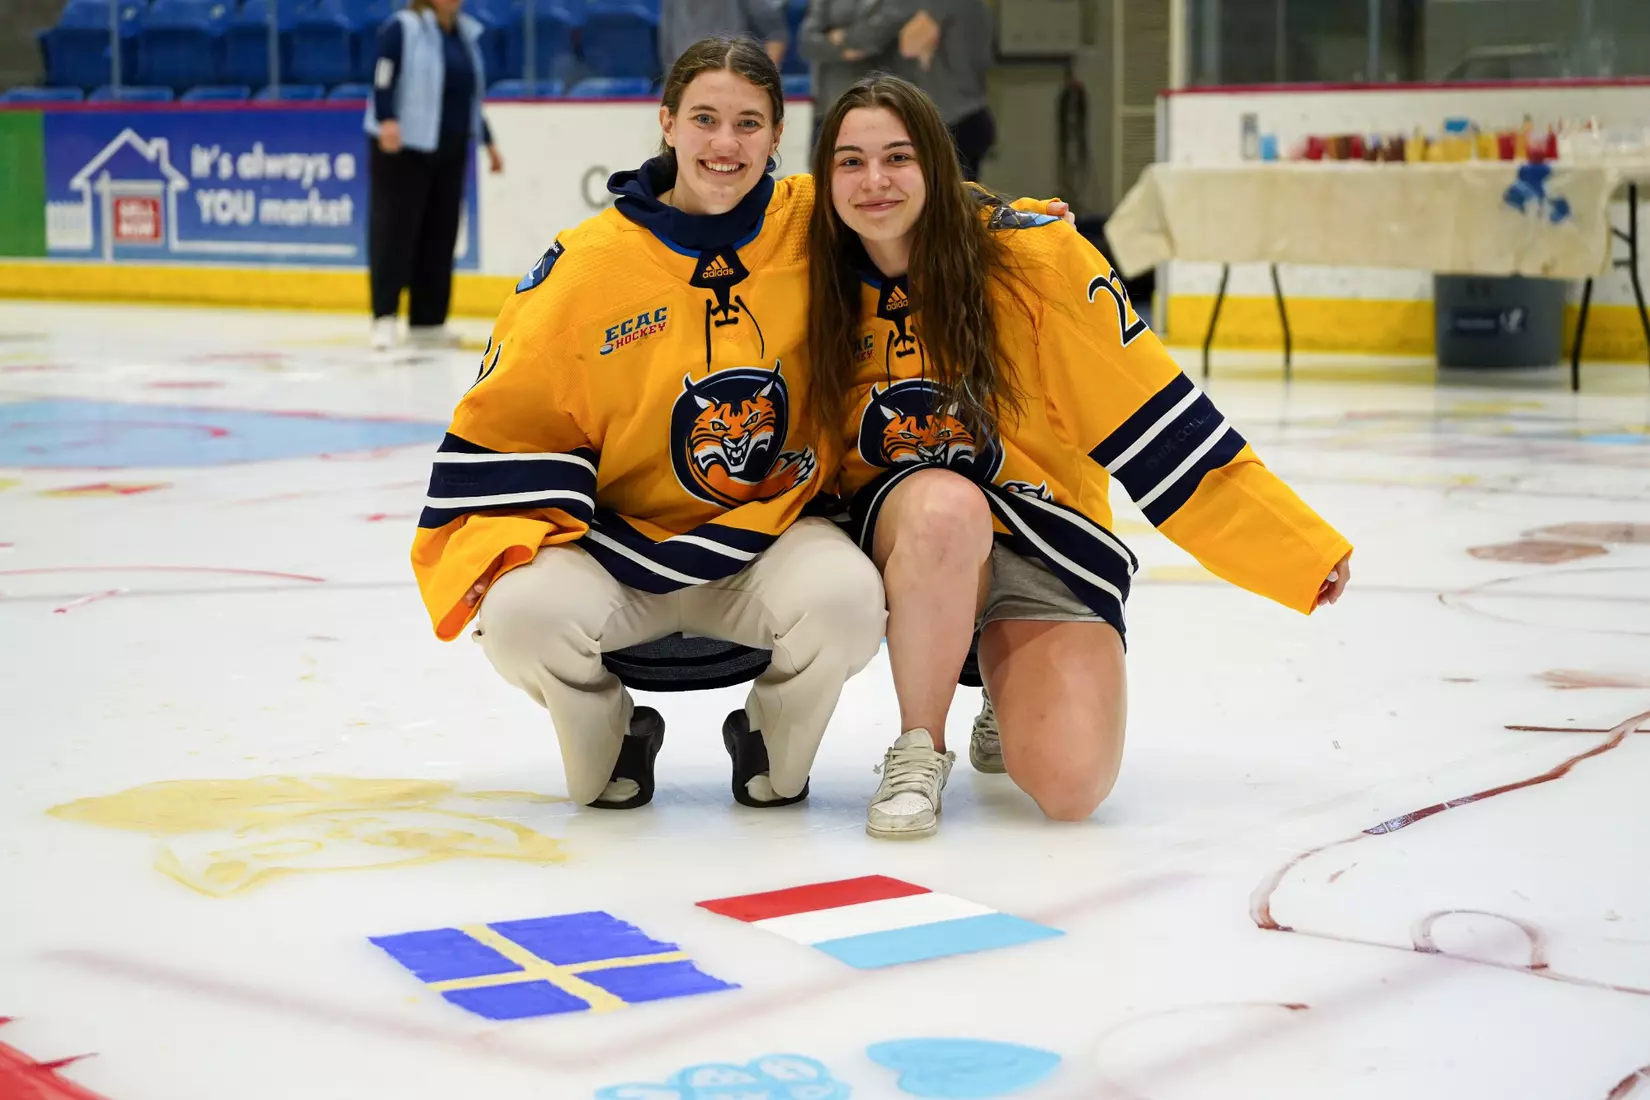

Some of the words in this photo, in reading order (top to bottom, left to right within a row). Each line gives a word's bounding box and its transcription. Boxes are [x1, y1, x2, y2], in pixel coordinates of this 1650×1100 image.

[191, 143, 234, 181] It's
[236, 141, 331, 190] always
[335, 152, 356, 181] a
[195, 188, 256, 226] YOU
[259, 187, 354, 227] market
[702, 267, 734, 279] adidas
[886, 299, 909, 311] adida
[605, 306, 668, 343] ECAC
[615, 322, 667, 350] HOCKEY
